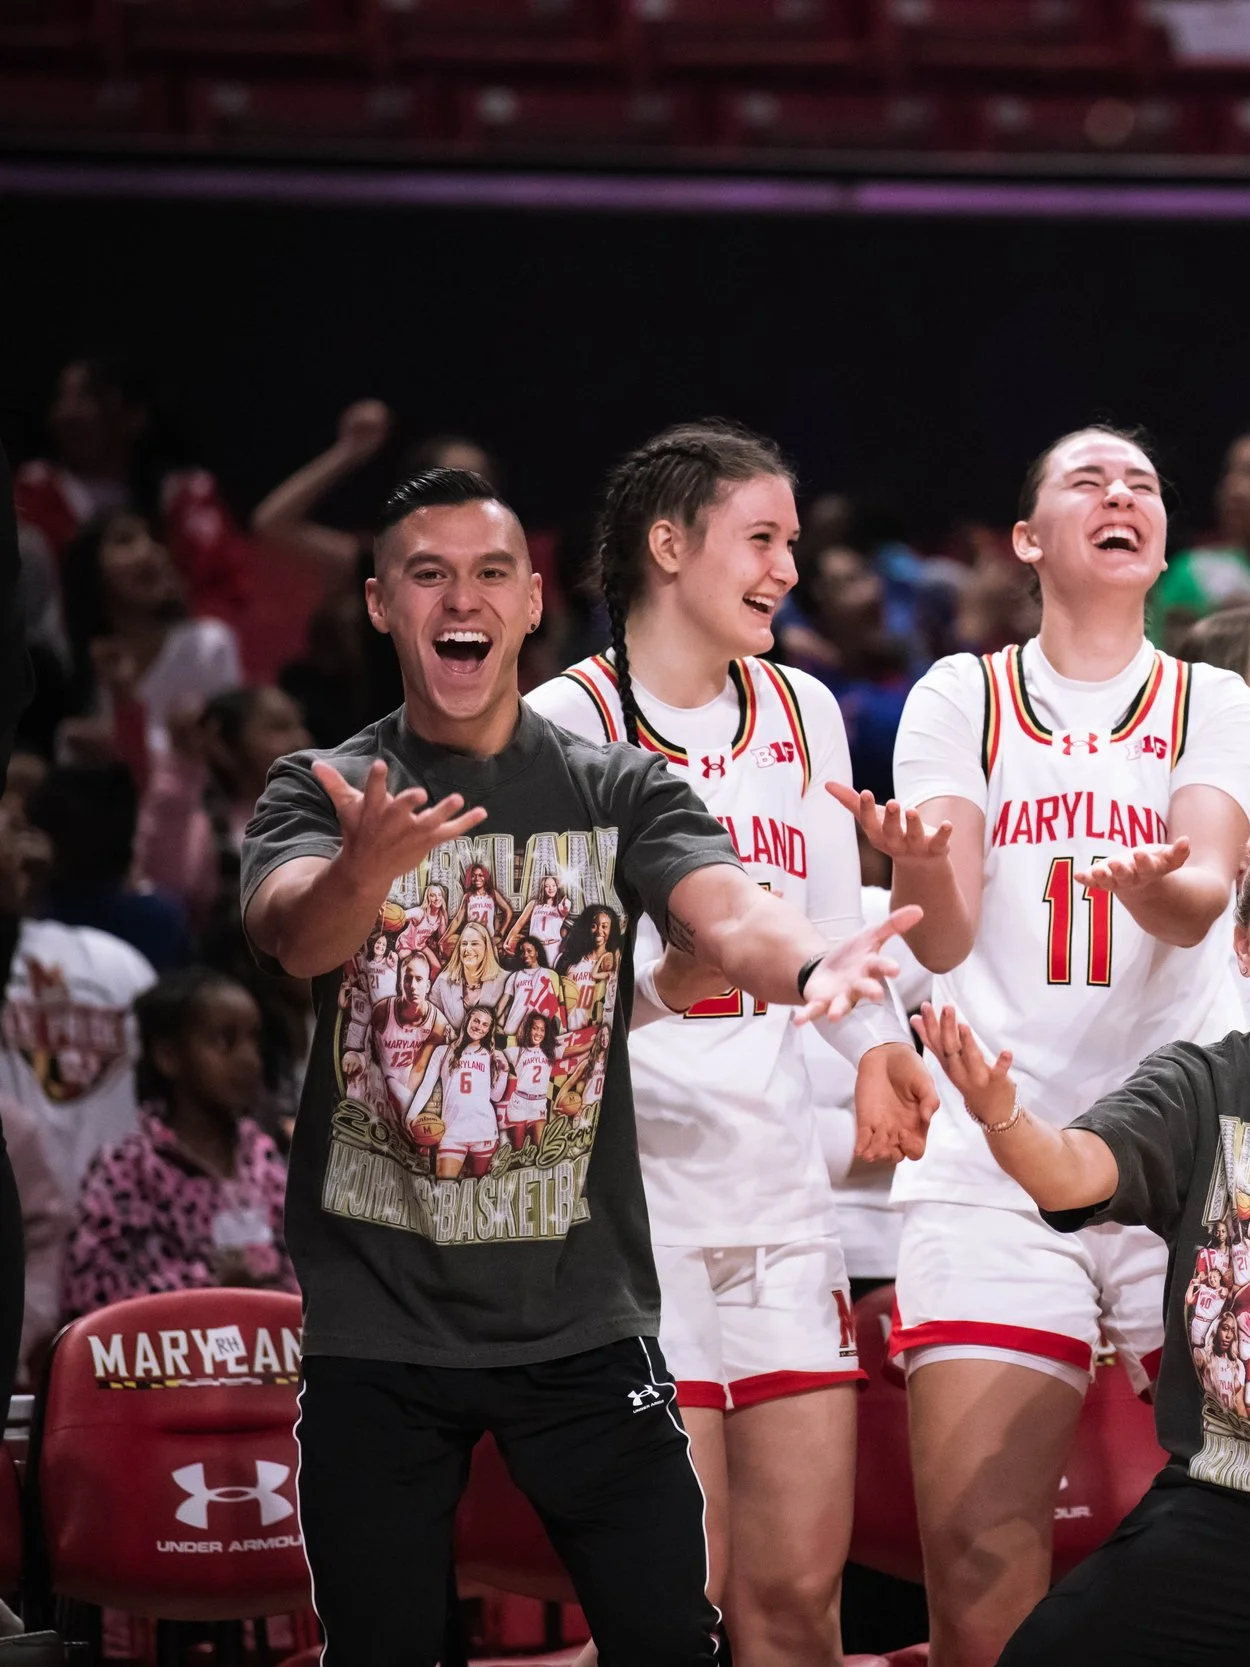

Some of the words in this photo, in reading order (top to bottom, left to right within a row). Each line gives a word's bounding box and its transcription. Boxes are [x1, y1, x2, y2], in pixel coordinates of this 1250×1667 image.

[716, 814, 808, 880] LAND
[1042, 856, 1115, 988] 11
[460, 1072, 472, 1095] 6
[532, 1066, 542, 1084] 2
[215, 1336, 241, 1356] RH
[156, 1539, 223, 1553] UNDER
[229, 1534, 303, 1551] ARMOU
